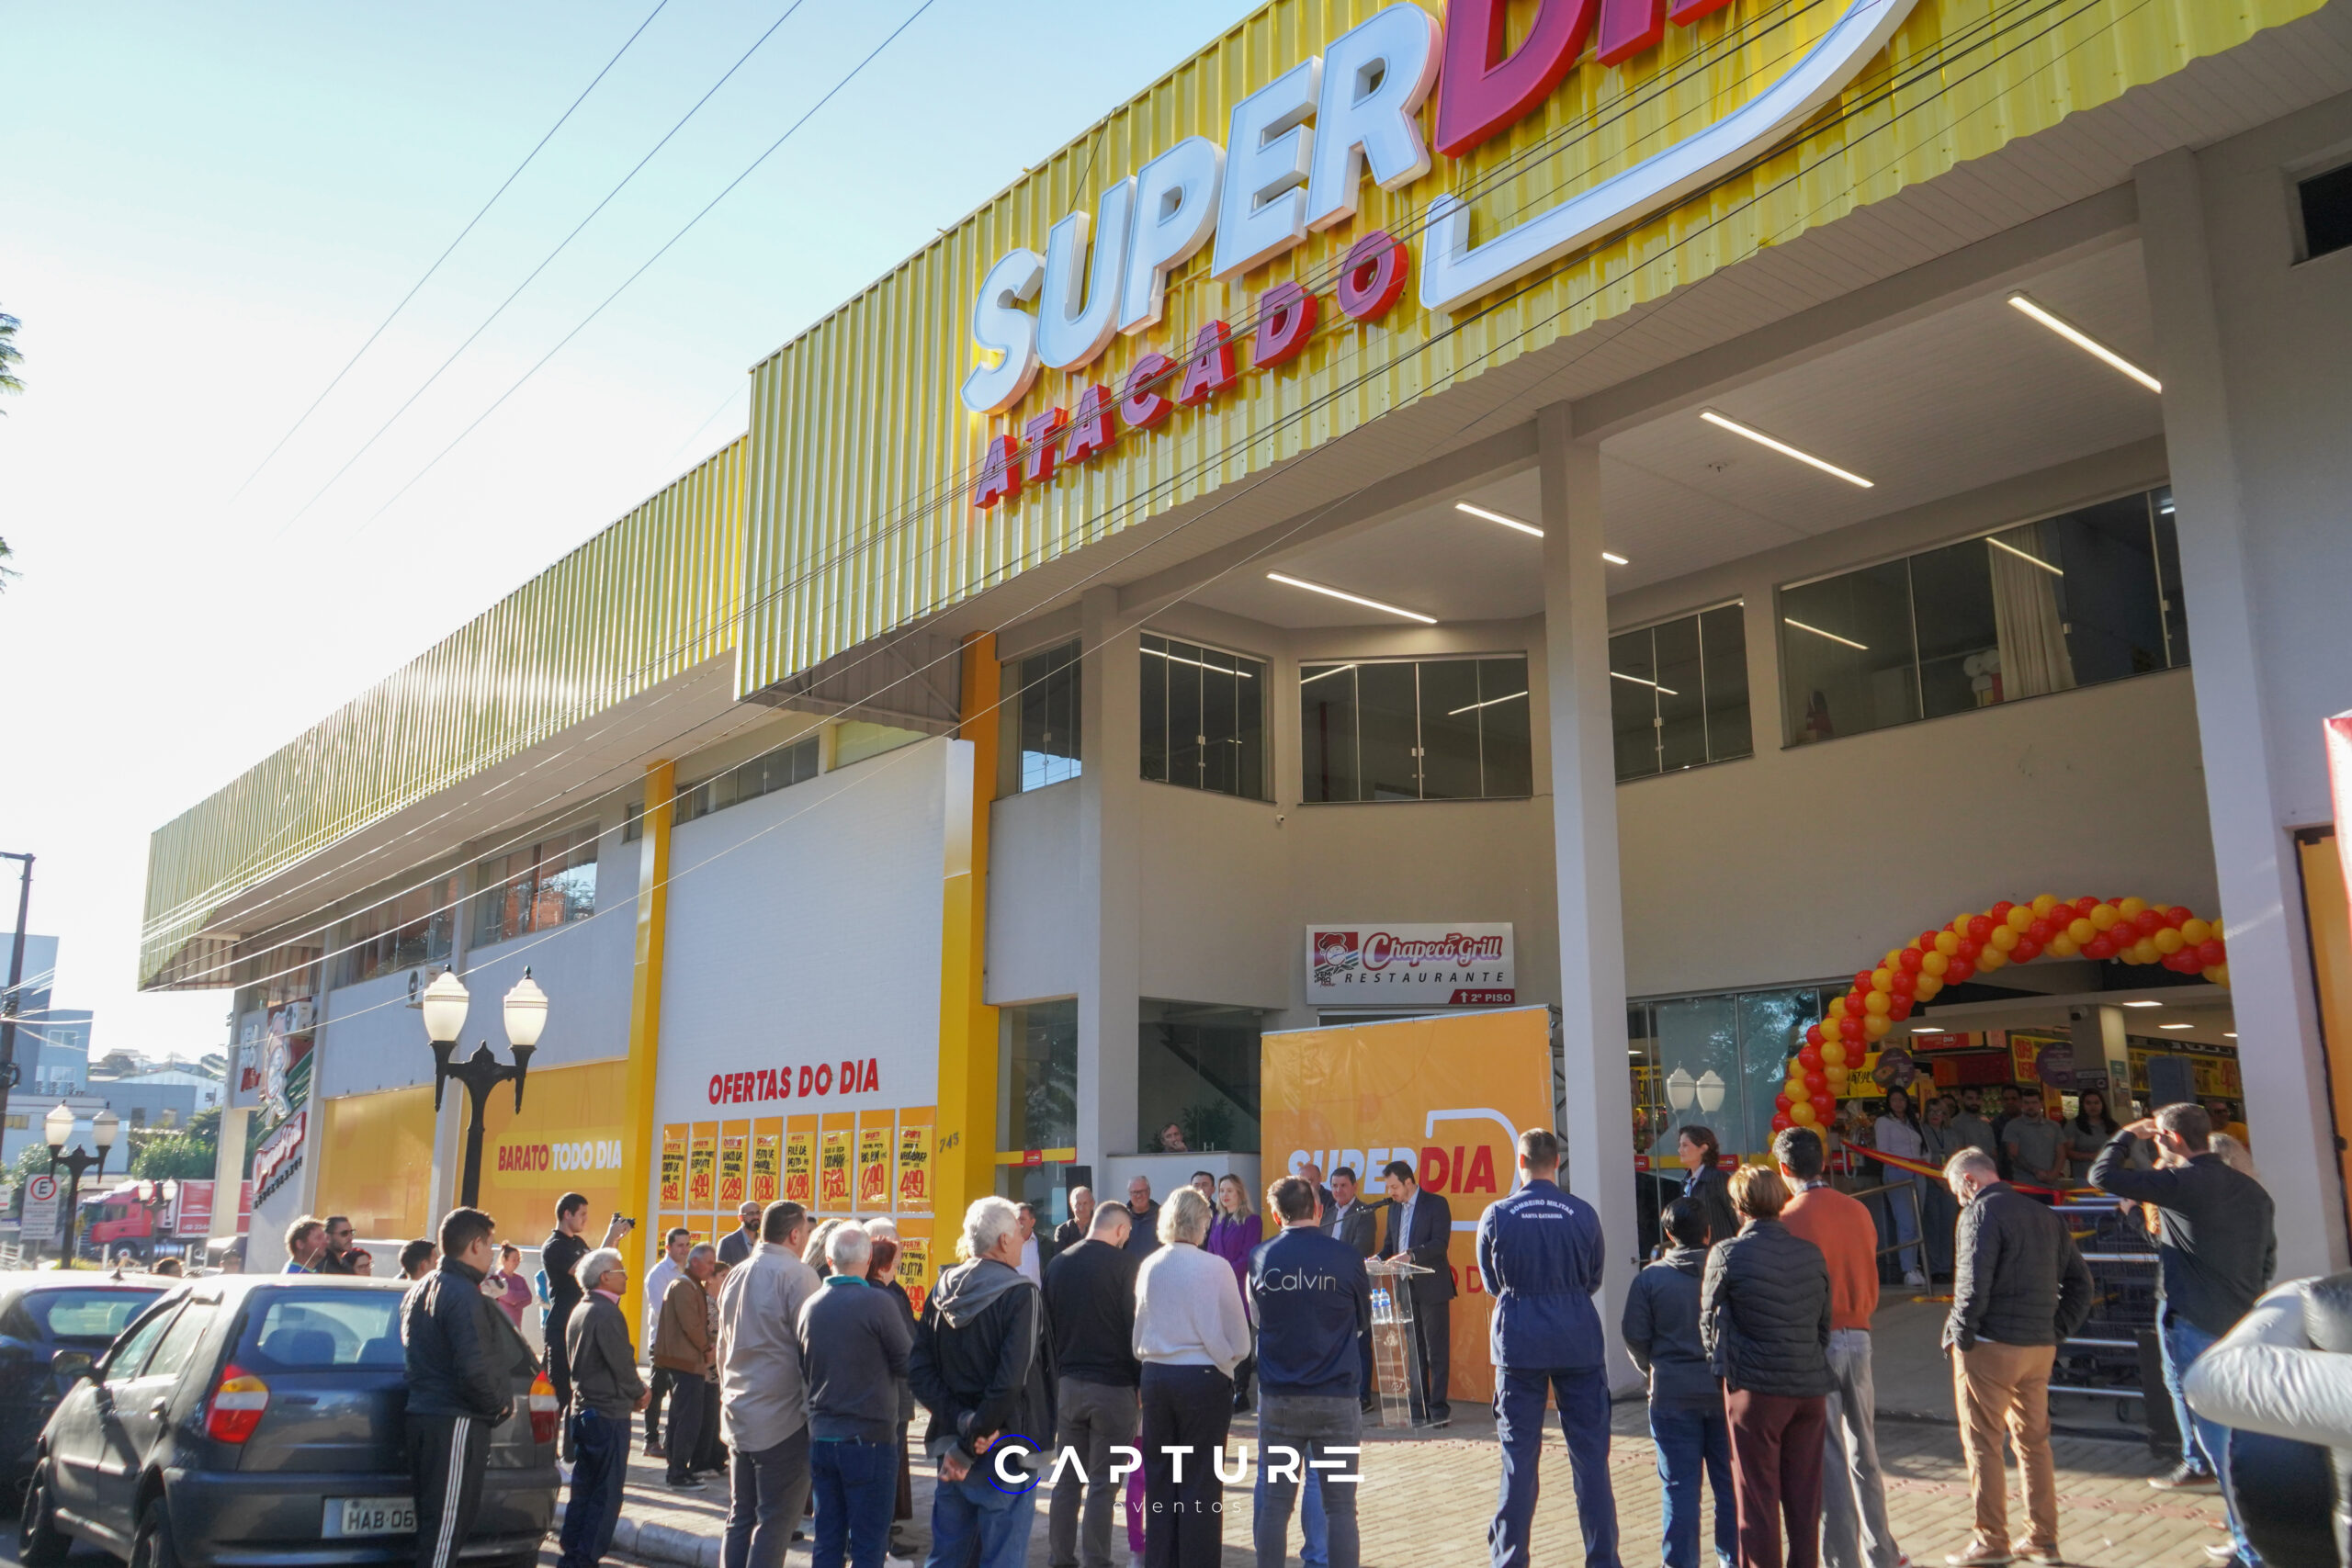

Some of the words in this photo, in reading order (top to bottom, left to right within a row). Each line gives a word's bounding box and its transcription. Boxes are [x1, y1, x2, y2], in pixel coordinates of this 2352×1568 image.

[961, 0, 1735, 416] SUPERD
[974, 229, 1409, 511] ATACADO
[1363, 932, 1459, 971] Chapecó
[1457, 935, 1502, 967] Grill
[1345, 972, 1504, 983] RESTAURANTE
[1485, 994, 1511, 1002] PISO
[708, 1066, 792, 1105] OFERTAS
[797, 1063, 832, 1098] DO
[839, 1058, 879, 1094] DIA
[498, 1144, 549, 1171] BARATO
[552, 1141, 594, 1171] TODO
[595, 1139, 622, 1169] DIA
[38, 1180, 48, 1195] E
[1510, 1199, 1545, 1215] BOMBEIRO
[1546, 1200, 1574, 1216] MILITAR
[1263, 1268, 1336, 1292] Calvin
